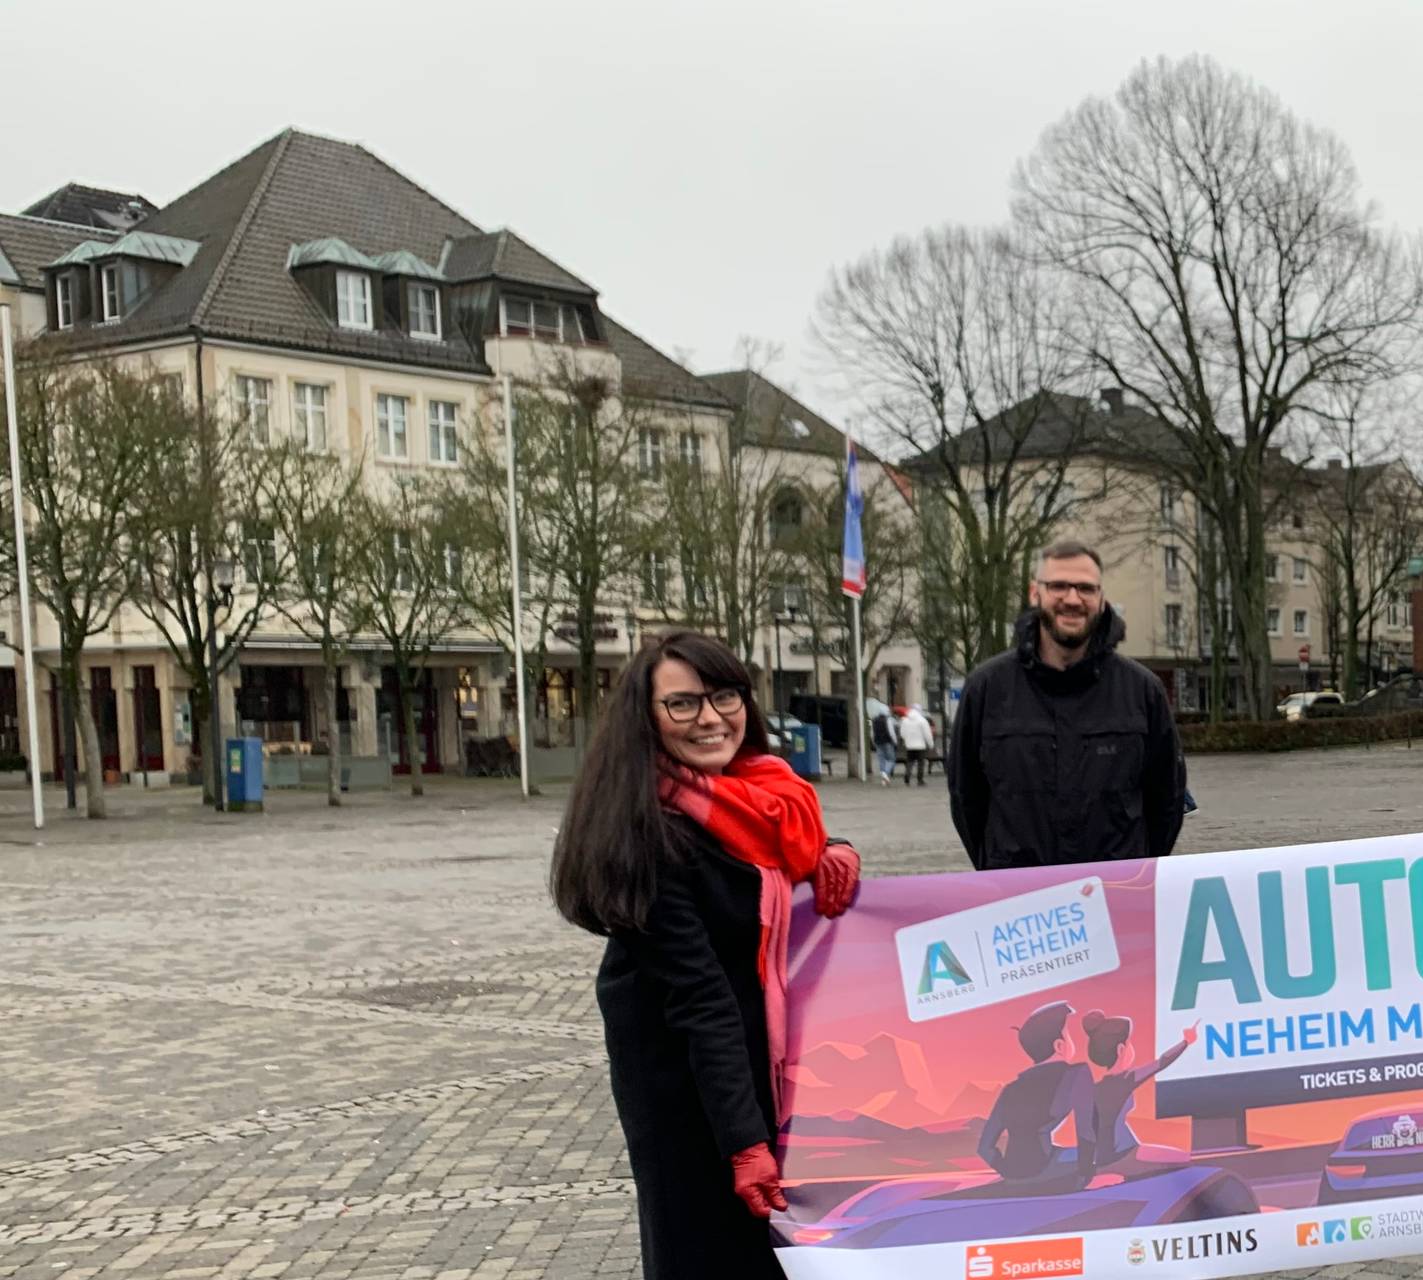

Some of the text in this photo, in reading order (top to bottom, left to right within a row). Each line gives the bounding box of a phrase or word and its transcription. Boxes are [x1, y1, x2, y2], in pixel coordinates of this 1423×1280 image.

[992, 902, 1085, 945] AKTIVES
[995, 924, 1088, 967] NEHEIM
[1000, 949, 1091, 984] PRÄSENTIERT
[917, 984, 976, 1005] ARNSBERG
[1204, 1008, 1375, 1060] NEHEIM
[1300, 1069, 1366, 1090] TICKETS
[1368, 1068, 1383, 1084] &
[1372, 1134, 1395, 1149] HERR
[1151, 1228, 1258, 1262] VELTINS
[1001, 1257, 1082, 1278] Sparkasse
